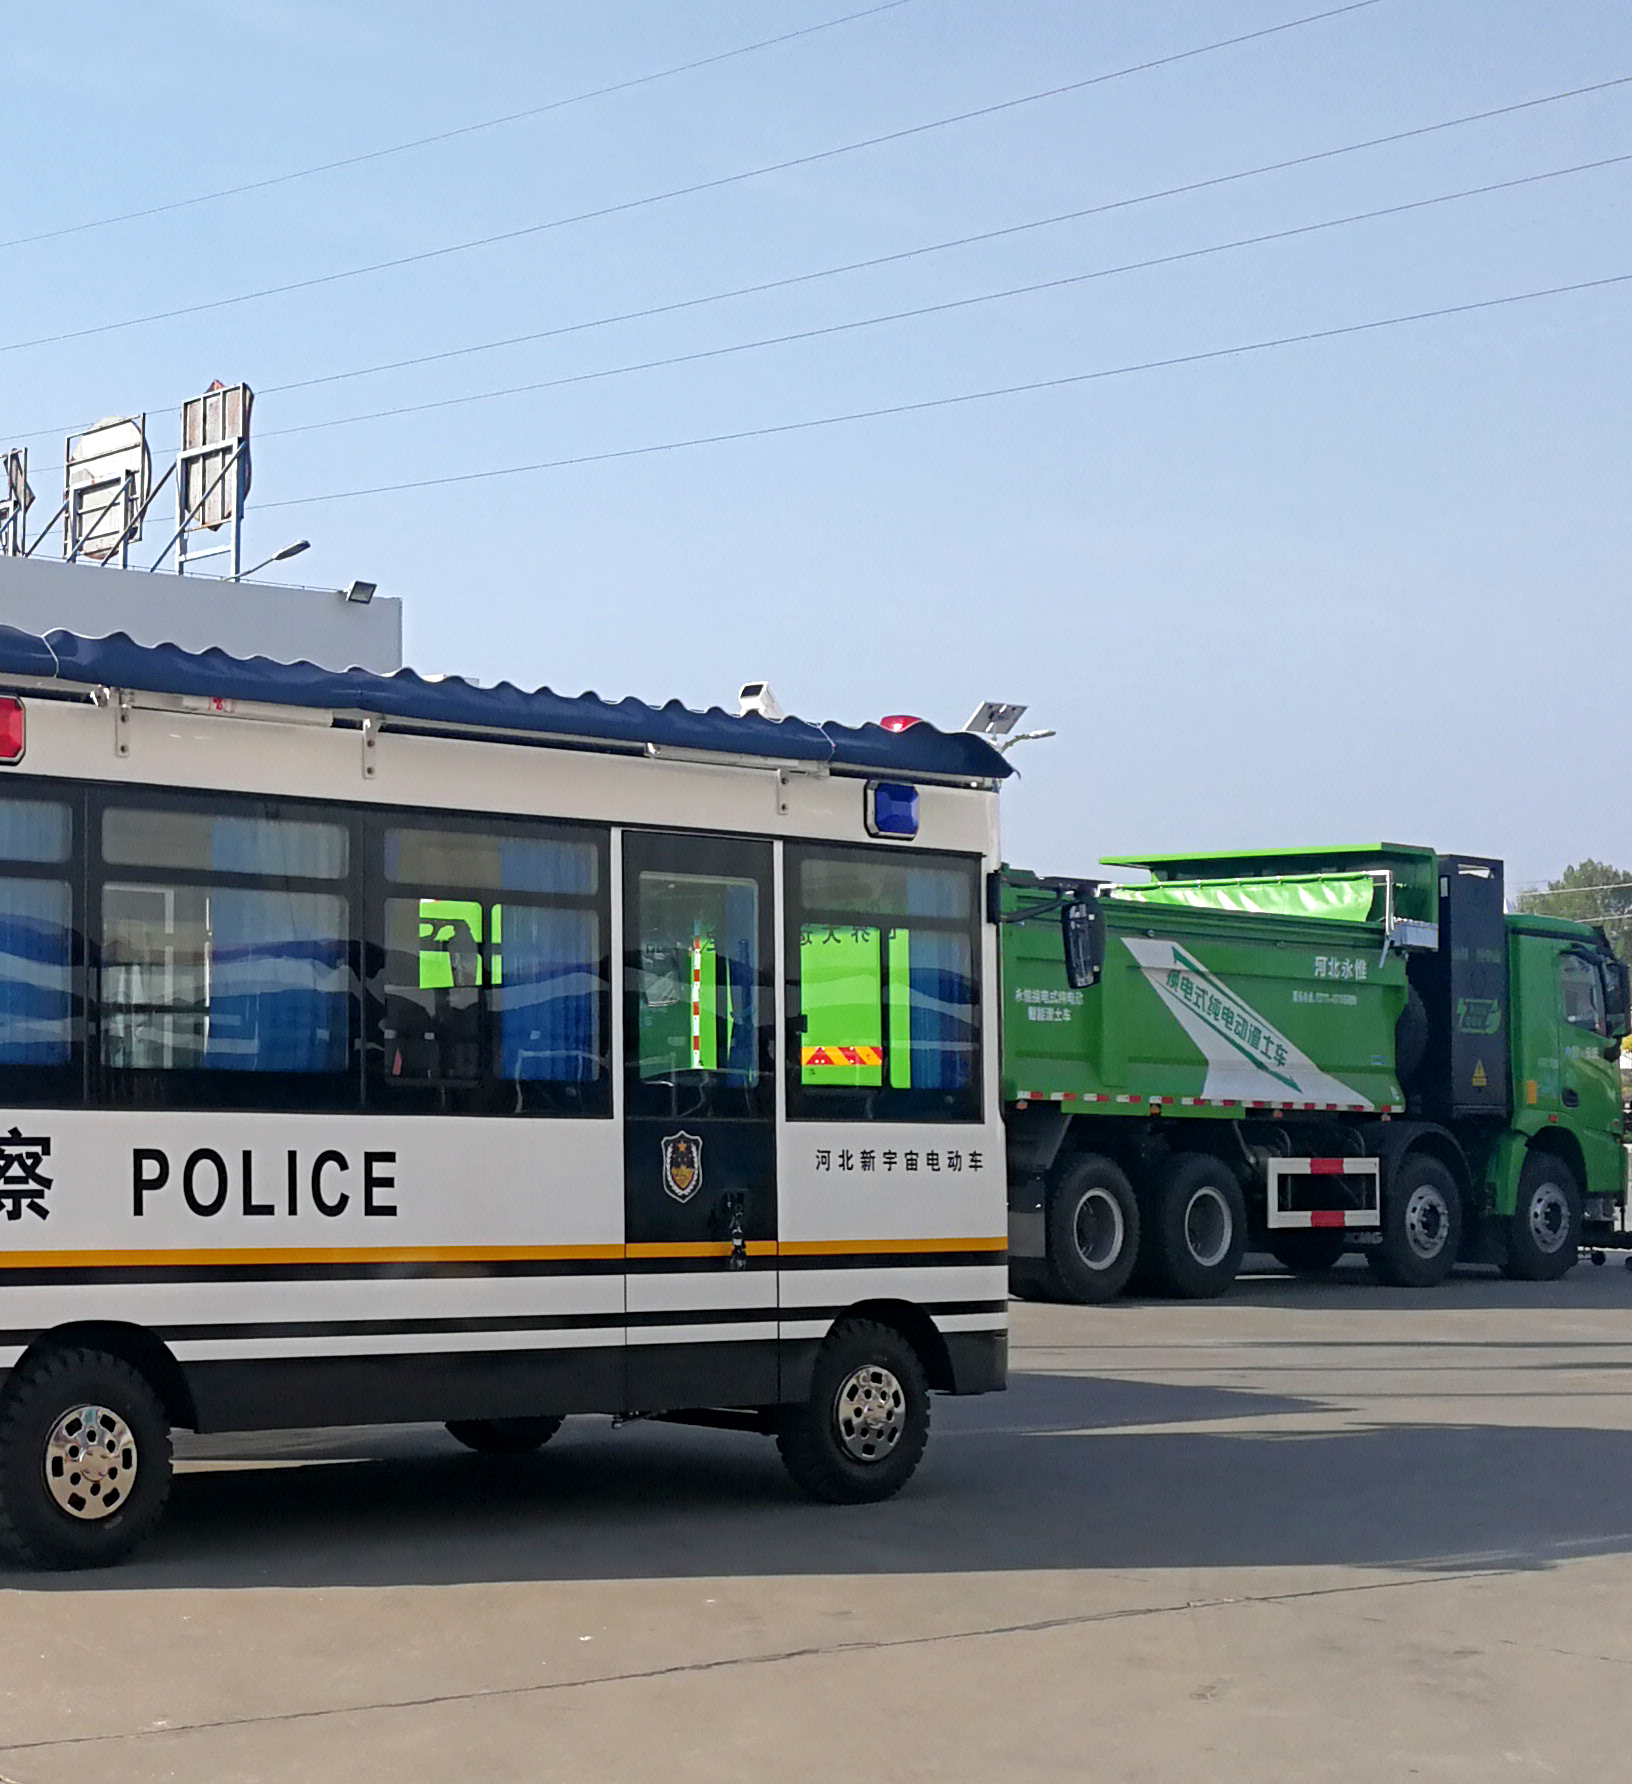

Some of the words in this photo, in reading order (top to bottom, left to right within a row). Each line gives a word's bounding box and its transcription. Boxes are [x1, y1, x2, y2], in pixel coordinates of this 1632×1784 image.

[132, 1147, 399, 1218] POLICE
[815, 1149, 984, 1173] 河北新宇宙电动车
